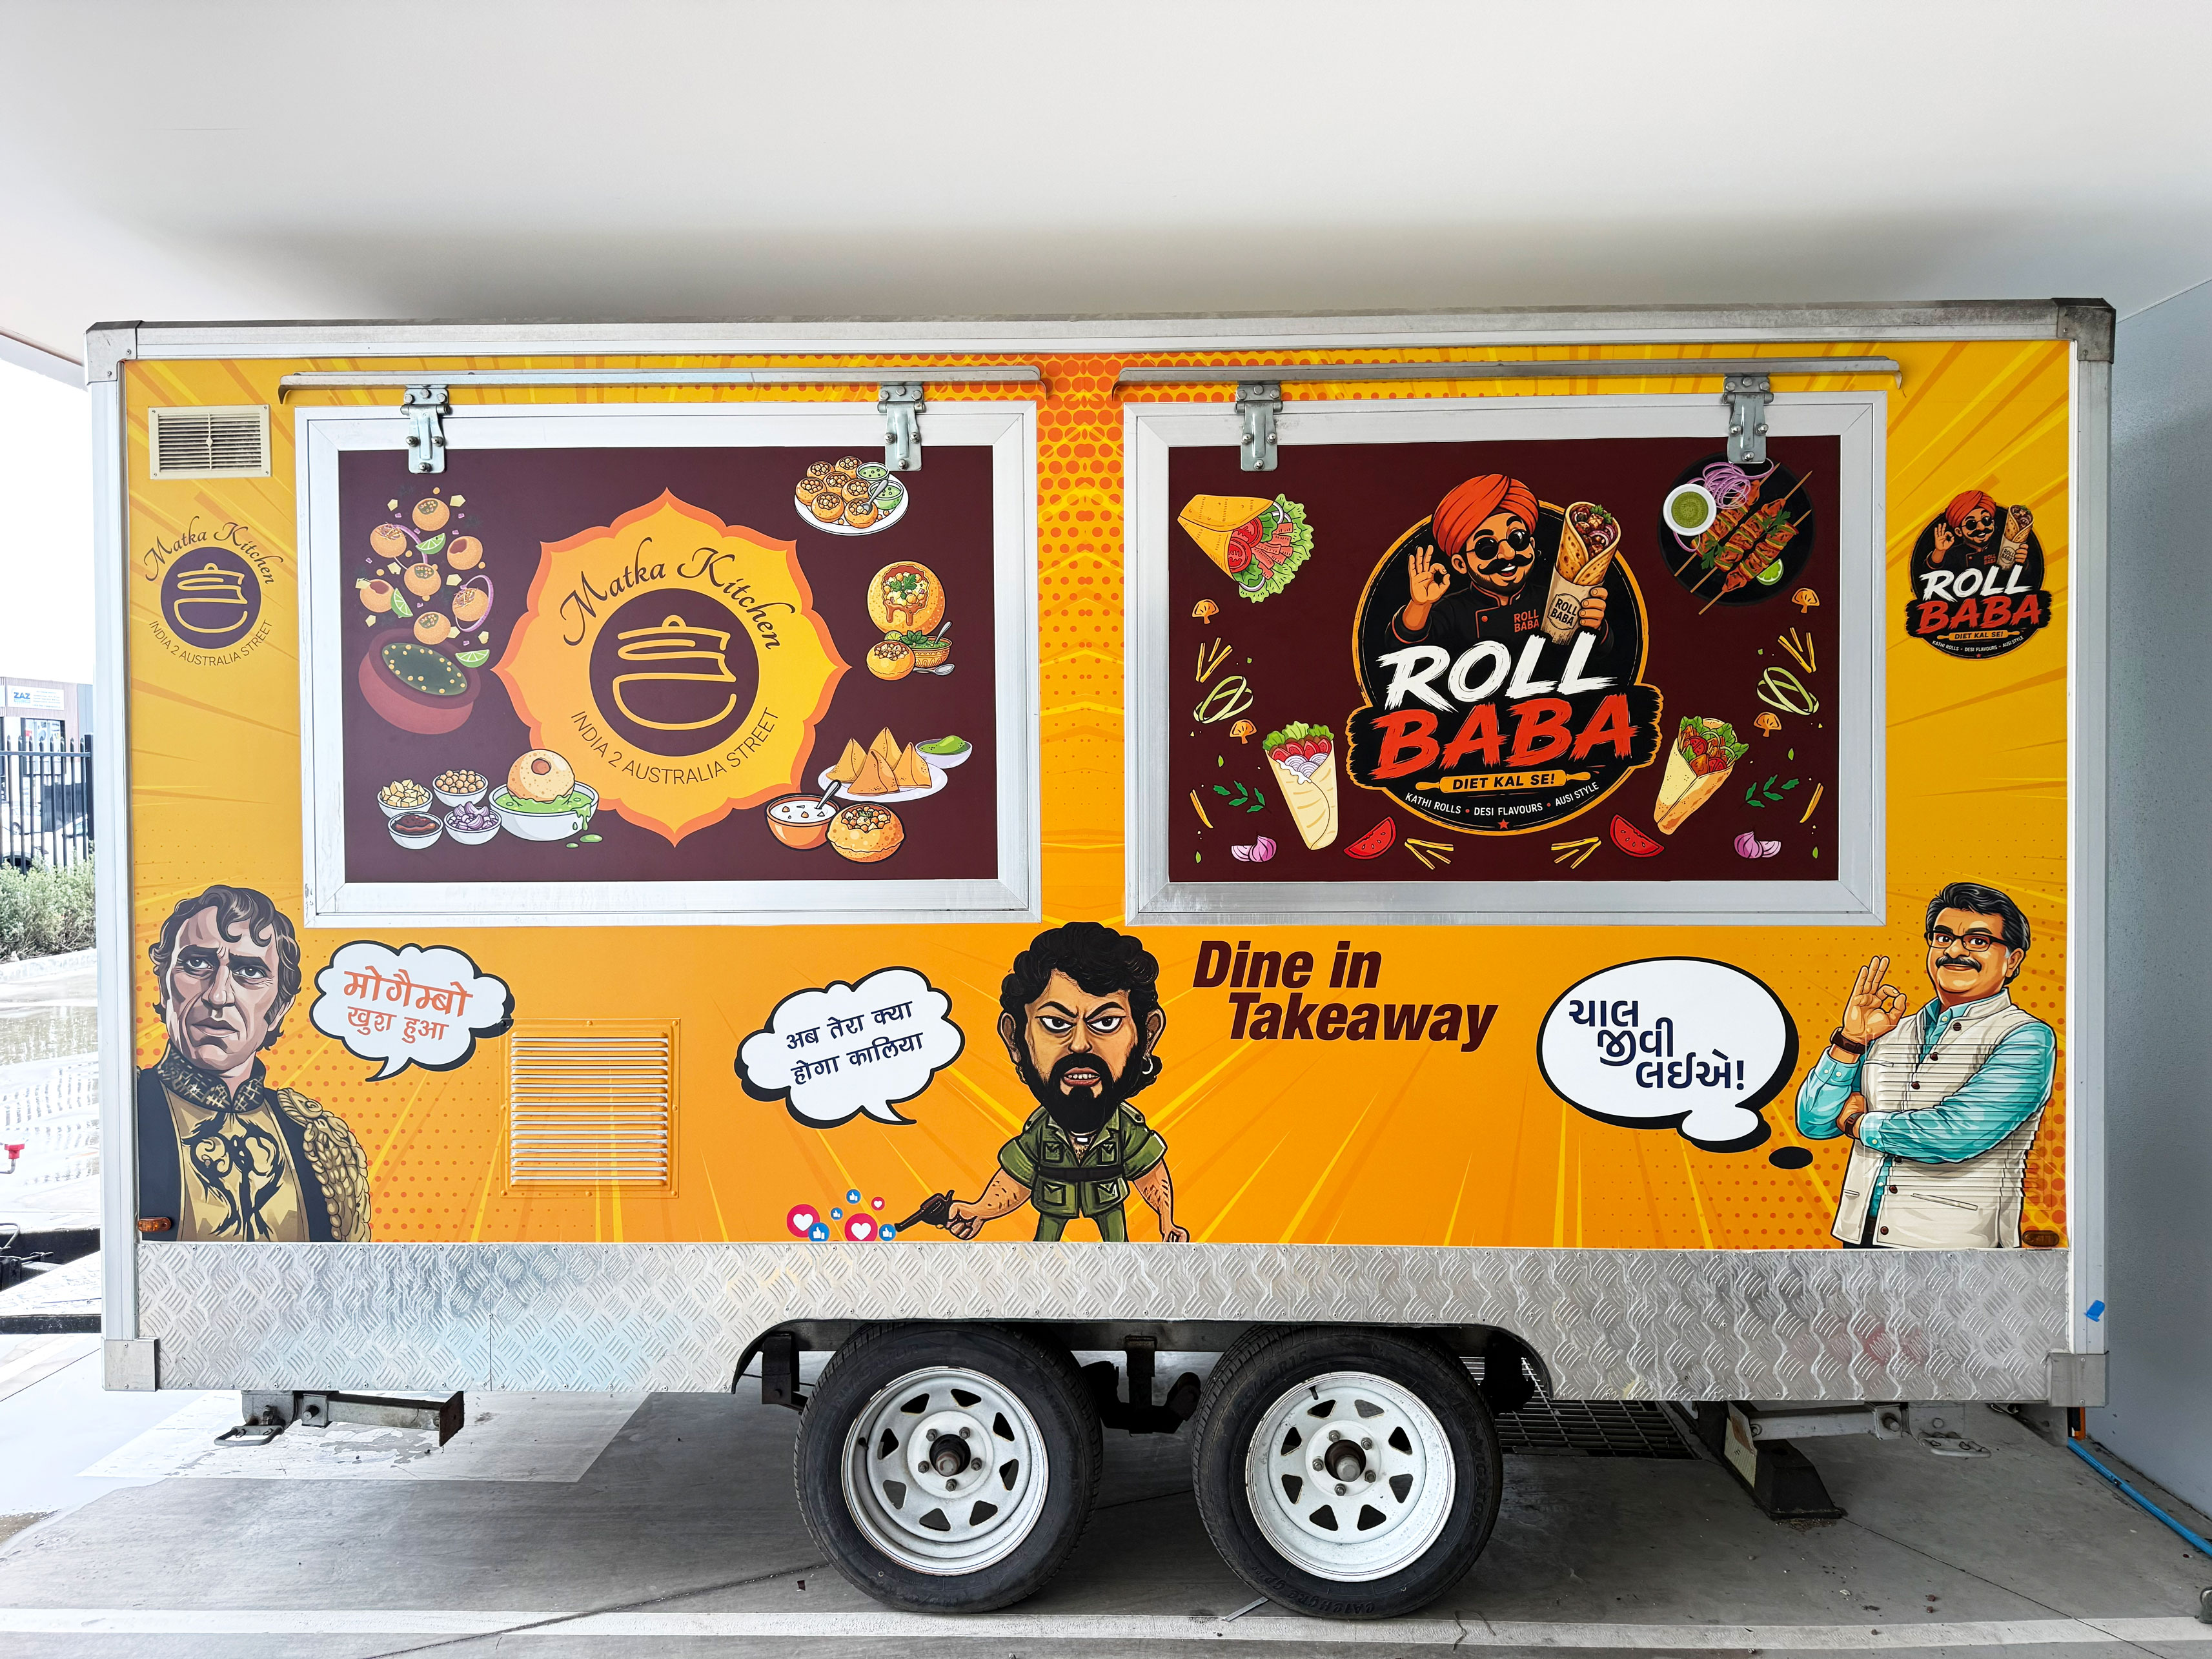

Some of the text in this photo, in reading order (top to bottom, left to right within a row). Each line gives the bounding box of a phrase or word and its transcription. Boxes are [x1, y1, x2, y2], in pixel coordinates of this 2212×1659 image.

[143, 516, 283, 585] Matka Kitchen
[560, 537, 795, 649] Matka Kitchen
[1919, 564, 2033, 602] ROLL
[1514, 609, 1539, 623] ROLL
[1514, 619, 1539, 633] BABA
[1550, 608, 1574, 626] BABA
[1555, 598, 1578, 616] ROLL
[1916, 594, 2042, 635] BABA
[149, 619, 272, 666] INDIA 2 AUSTRALIA STREET
[2012, 635, 2024, 644] STYLE
[1375, 631, 1617, 713] ROLL
[571, 707, 778, 785] INDIA 2 AUSTRALIA STREET
[1369, 694, 1639, 780] BABA
[1405, 782, 1599, 815] KATHI ROLLS DESI FLAVOURS AUSI STYLE
[1452, 773, 1555, 790] DIET KAL SE!
[1192, 940, 1382, 988] Dine in
[343, 966, 473, 1017] मोगैम्बो
[1568, 1000, 1638, 1027] ચાલ
[347, 1006, 449, 1044] खुश हुआ
[786, 1001, 913, 1050] अब तेरा क्या
[1228, 992, 1499, 1052] Takeaway
[1598, 1017, 1674, 1066] જીવી
[790, 1032, 924, 1084] होगा कालिया
[1636, 1049, 1744, 1090] લઈએ!
